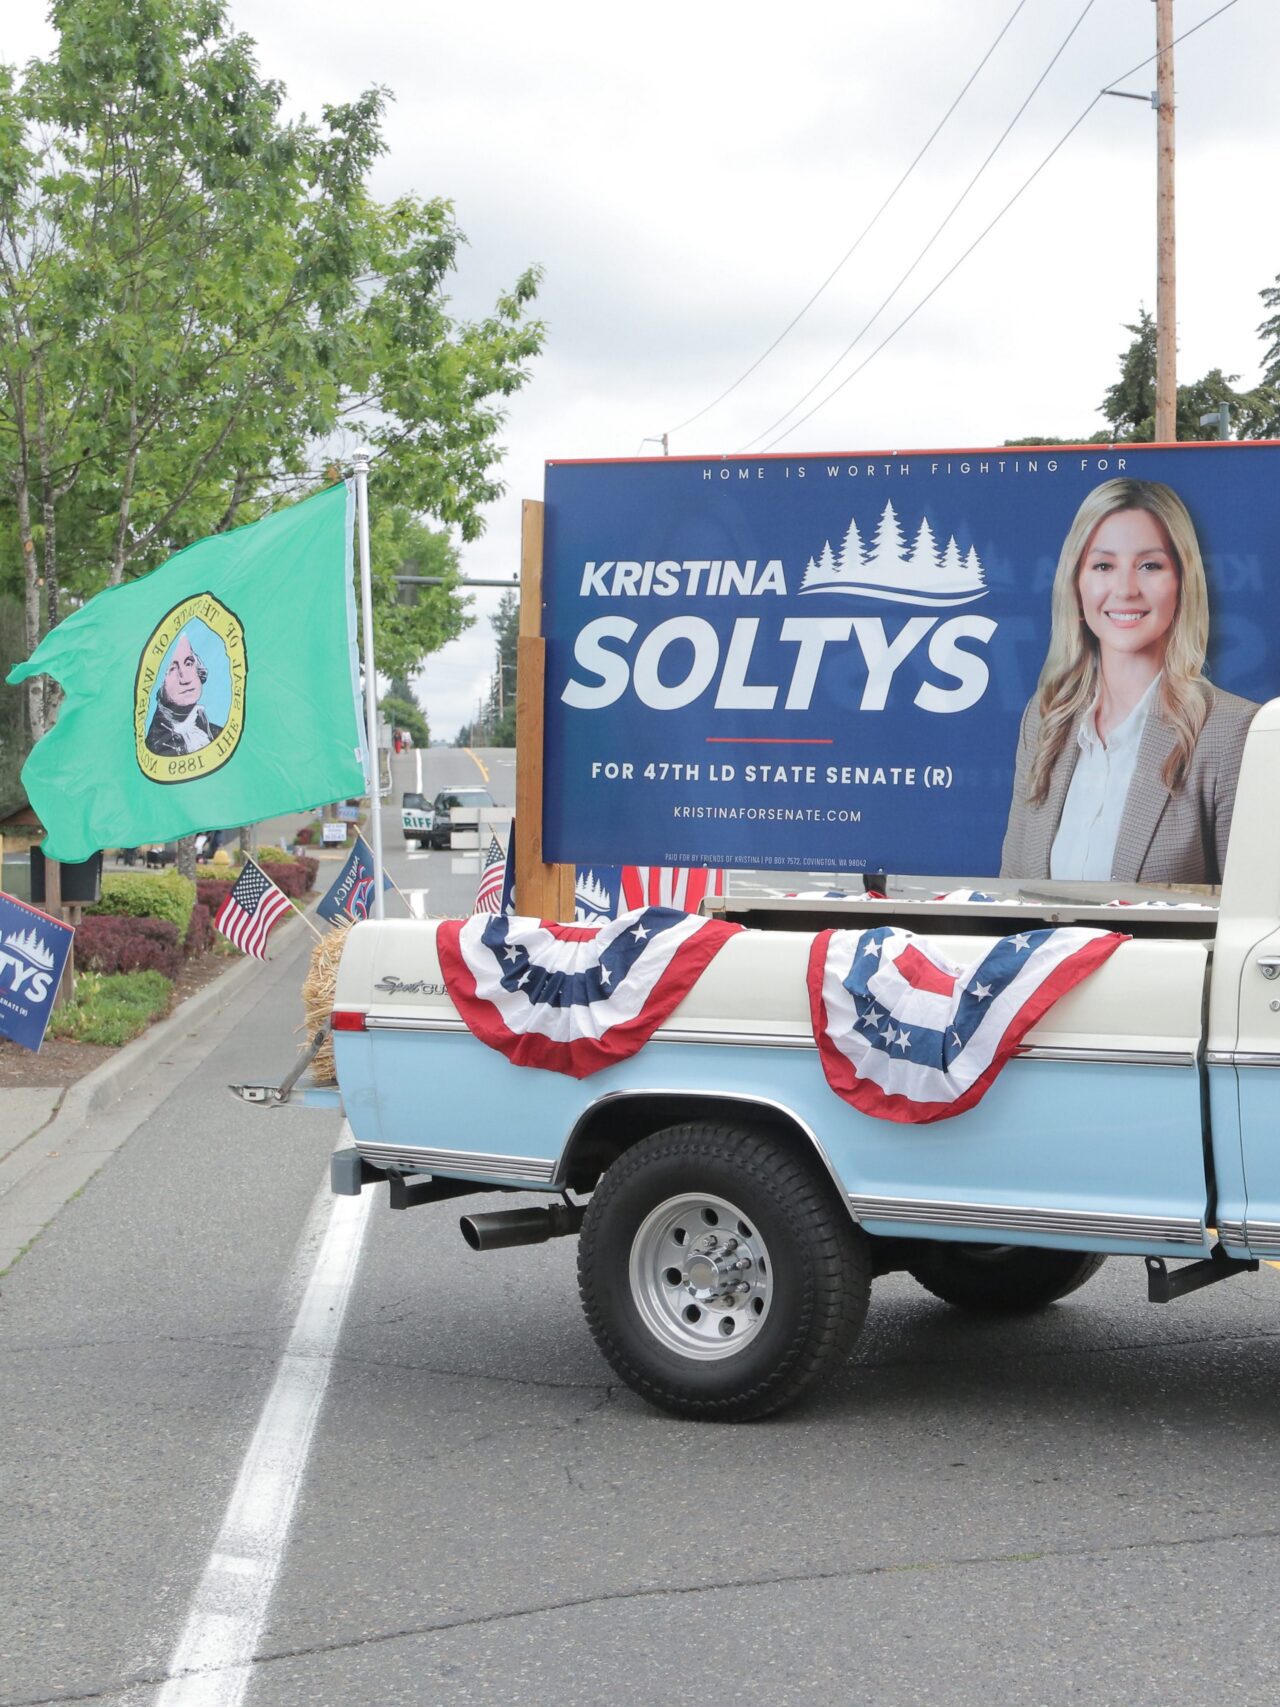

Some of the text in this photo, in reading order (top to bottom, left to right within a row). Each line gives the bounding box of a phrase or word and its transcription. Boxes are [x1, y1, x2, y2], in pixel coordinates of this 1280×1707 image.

[702, 458, 1127, 481] HOME IS WORTH FIGHTING FOR
[579, 560, 788, 597] KRISTINA
[560, 614, 1000, 714] SOLTYS
[591, 762, 953, 788] FOR 47TH LD STATE SENATE (R)
[673, 806, 862, 822] KRISTINAFORSENATE.COM
[664, 853, 678, 861] PAID
[680, 853, 690, 861] FOR
[700, 854, 724, 863] FRIENDS
[725, 855, 733, 863] OF
[734, 856, 761, 864] KRISTINA
[839, 858, 848, 867] WA
